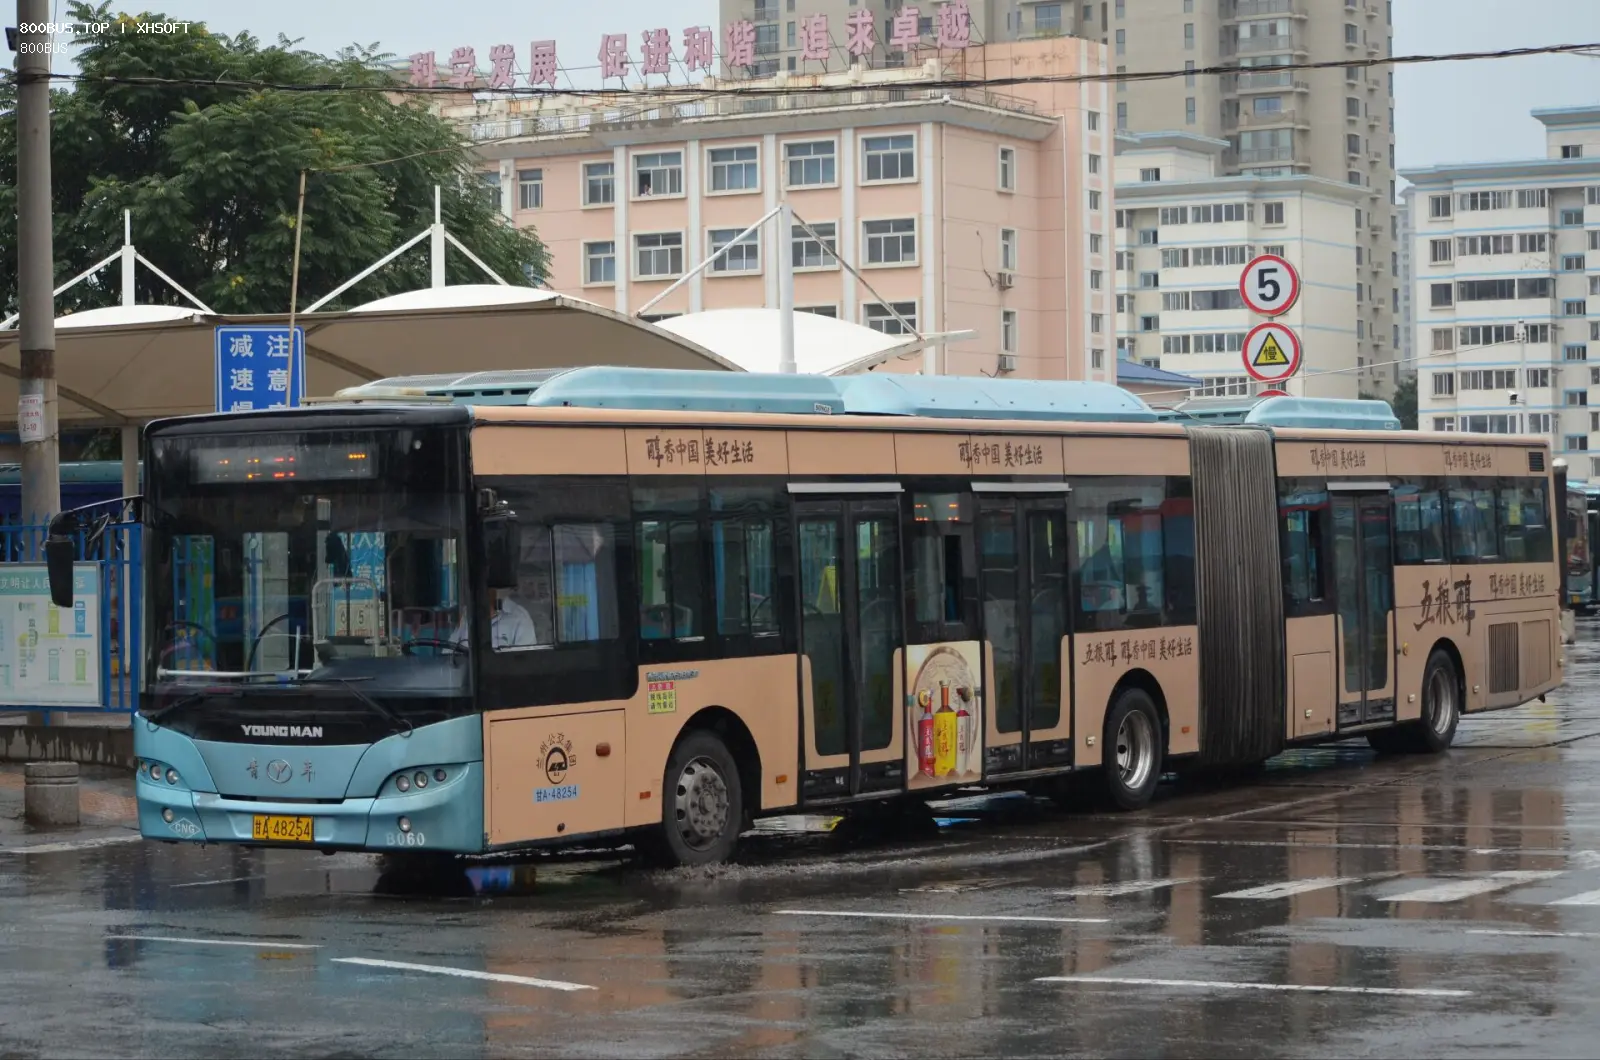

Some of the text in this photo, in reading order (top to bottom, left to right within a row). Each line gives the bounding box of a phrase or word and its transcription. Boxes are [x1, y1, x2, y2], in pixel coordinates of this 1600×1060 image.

[408, 0, 971, 88] 科学发展 促进和谐 追求卓越
[1257, 267, 1280, 302] 5
[1263, 345, 1277, 360] 慢
[704, 436, 755, 466] 美好生活
[1003, 441, 1042, 467] 美好生活
[1518, 571, 1545, 596] 美好生活
[1159, 636, 1192, 661] 美好生活
[174, 823, 196, 834] CNG
